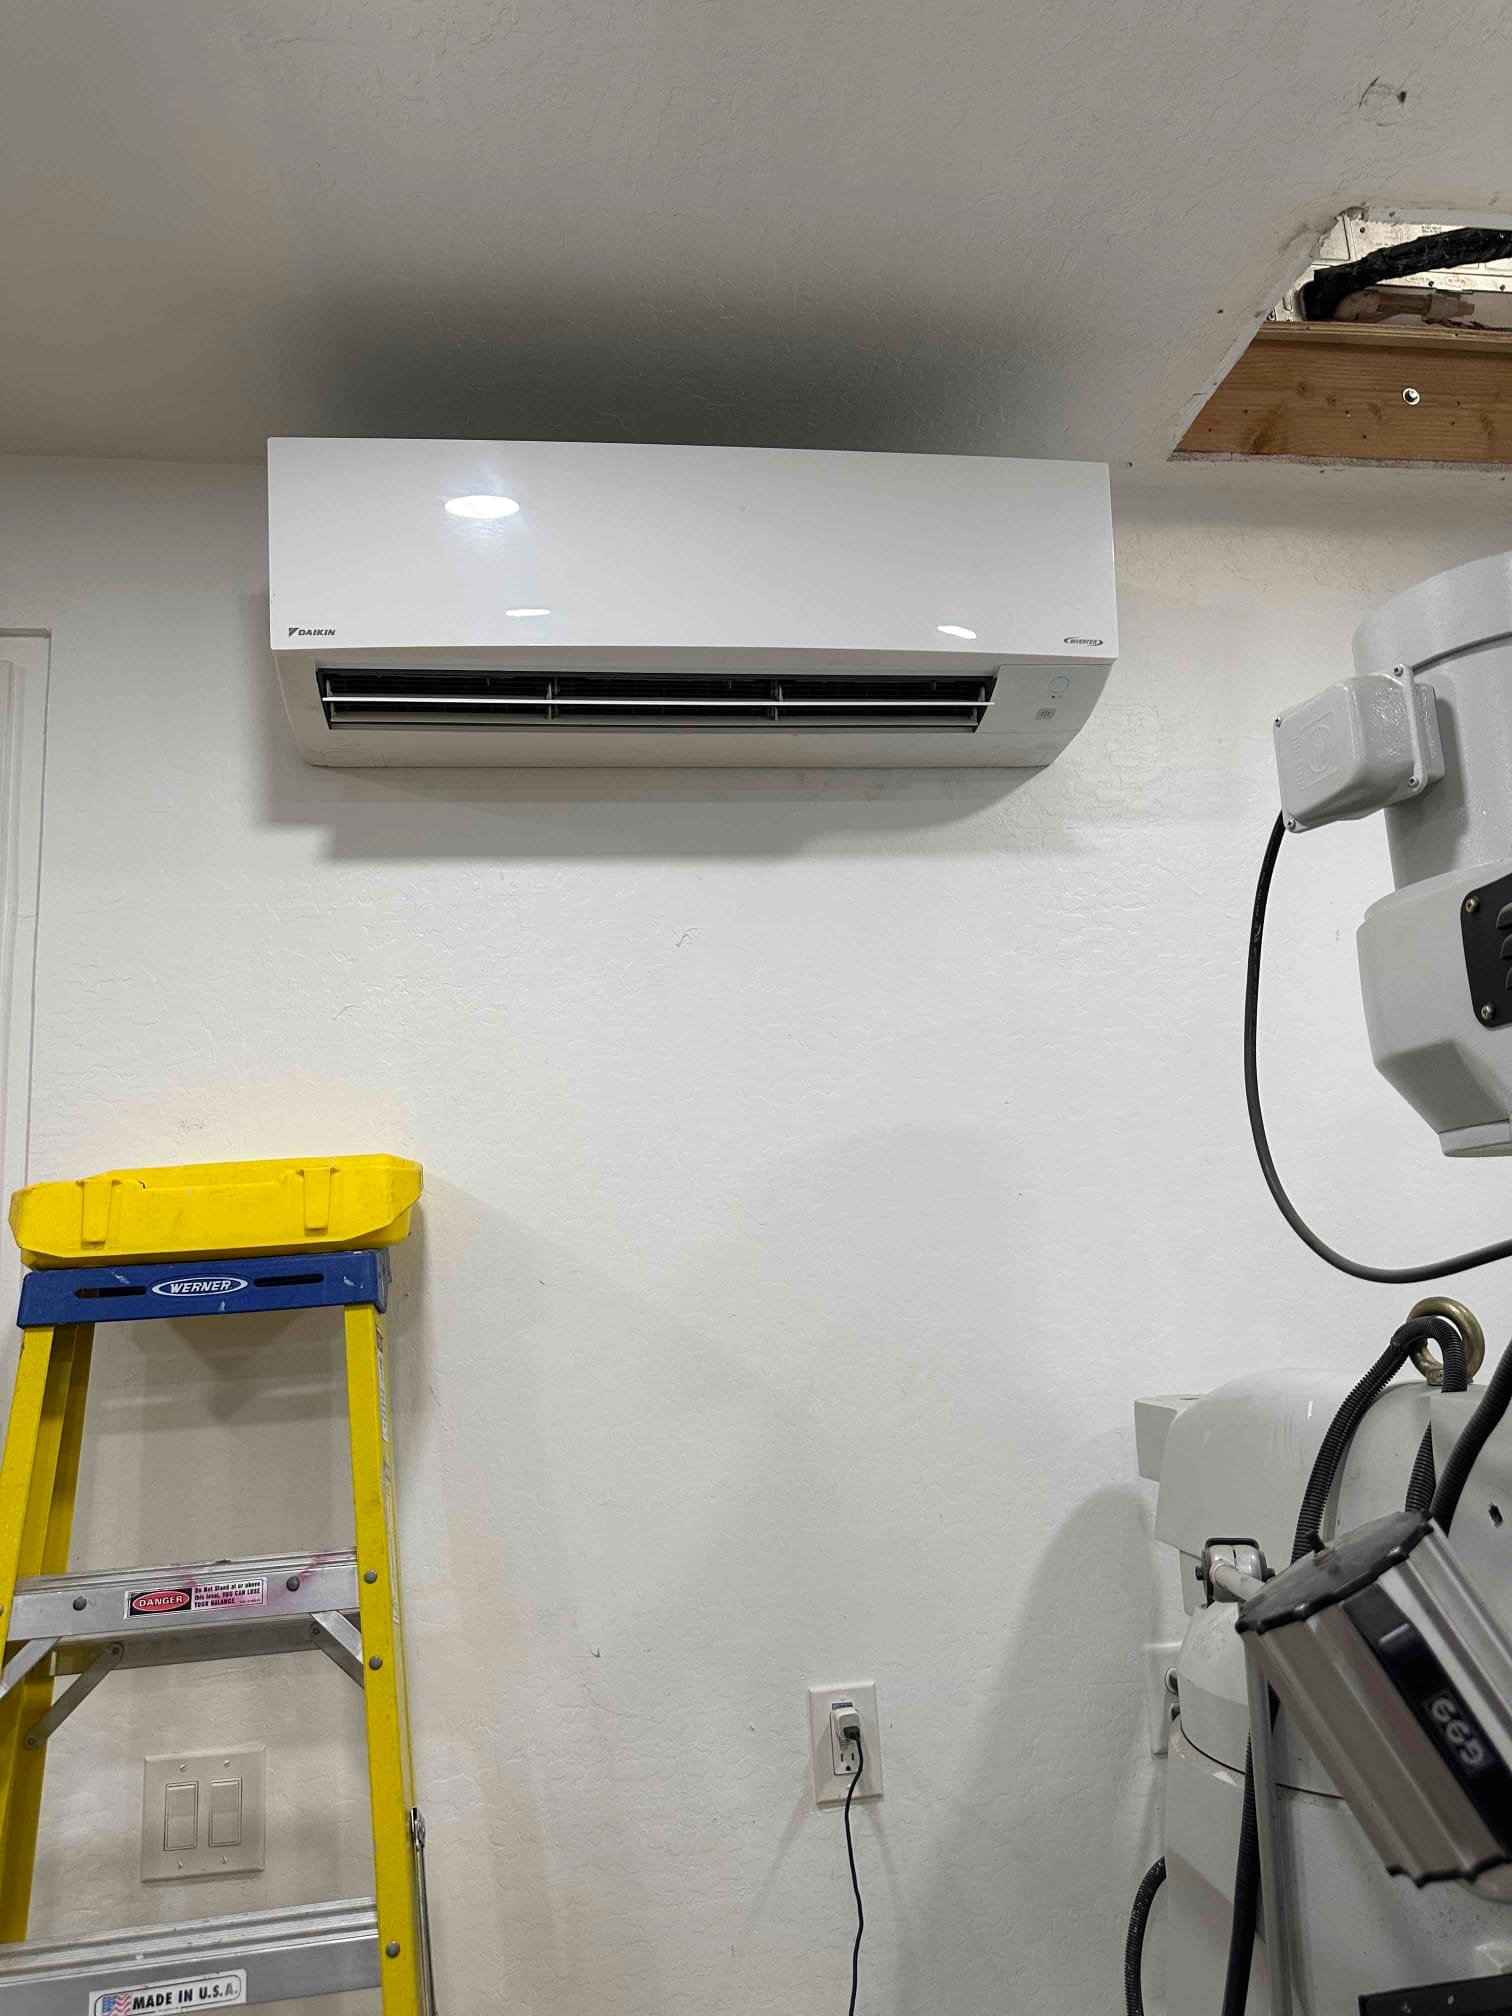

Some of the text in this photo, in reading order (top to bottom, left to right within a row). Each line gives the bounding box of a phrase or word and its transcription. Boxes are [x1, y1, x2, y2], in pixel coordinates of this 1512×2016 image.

[170, 1280, 231, 1294] WERNER
[139, 1595, 183, 1607] DANGER
[132, 1982, 238, 2010] MADE IN U.S.A.
